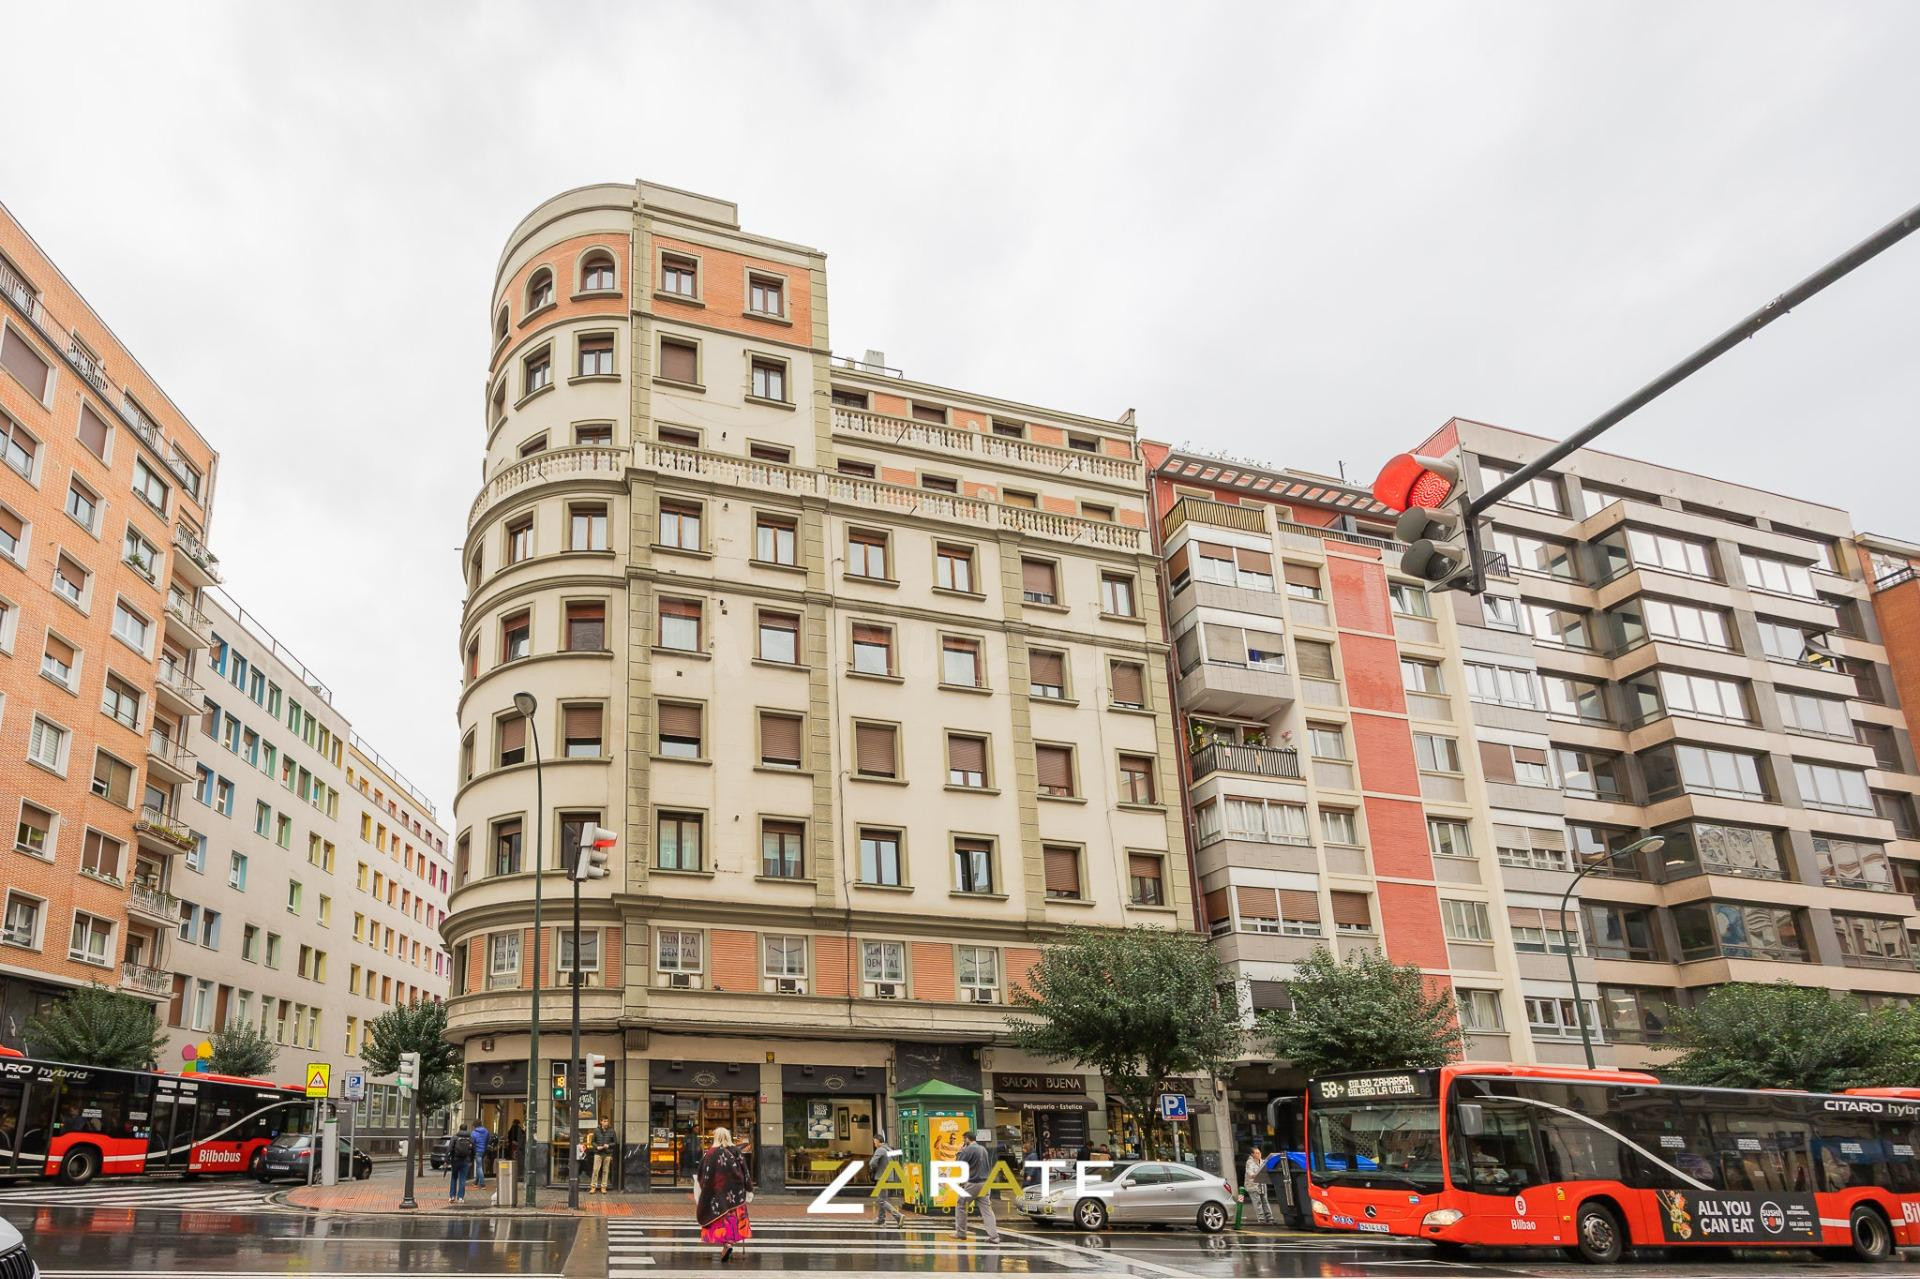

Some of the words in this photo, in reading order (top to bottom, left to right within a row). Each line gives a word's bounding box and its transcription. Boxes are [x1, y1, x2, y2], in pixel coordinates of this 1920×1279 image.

[37, 1066, 88, 1080] hybrid
[1002, 1076, 1038, 1088] SALON
[1046, 1077, 1081, 1089] BUENA
[1320, 1081, 1339, 1099] 58
[1348, 1087, 1376, 1097] BILBAO
[1377, 1087, 1388, 1095] LA
[1389, 1084, 1415, 1094] VIEJA
[1164, 1096, 1179, 1116] P
[1824, 1100, 1883, 1113] CITARO
[198, 1149, 241, 1163] Bilbobus
[1698, 1200, 1722, 1216] ALL
[1722, 1200, 1752, 1216] YOU
[1511, 1218, 1536, 1230] Bilbao
[1700, 1218, 1730, 1233] CAN
[1732, 1218, 1755, 1233] EAT
